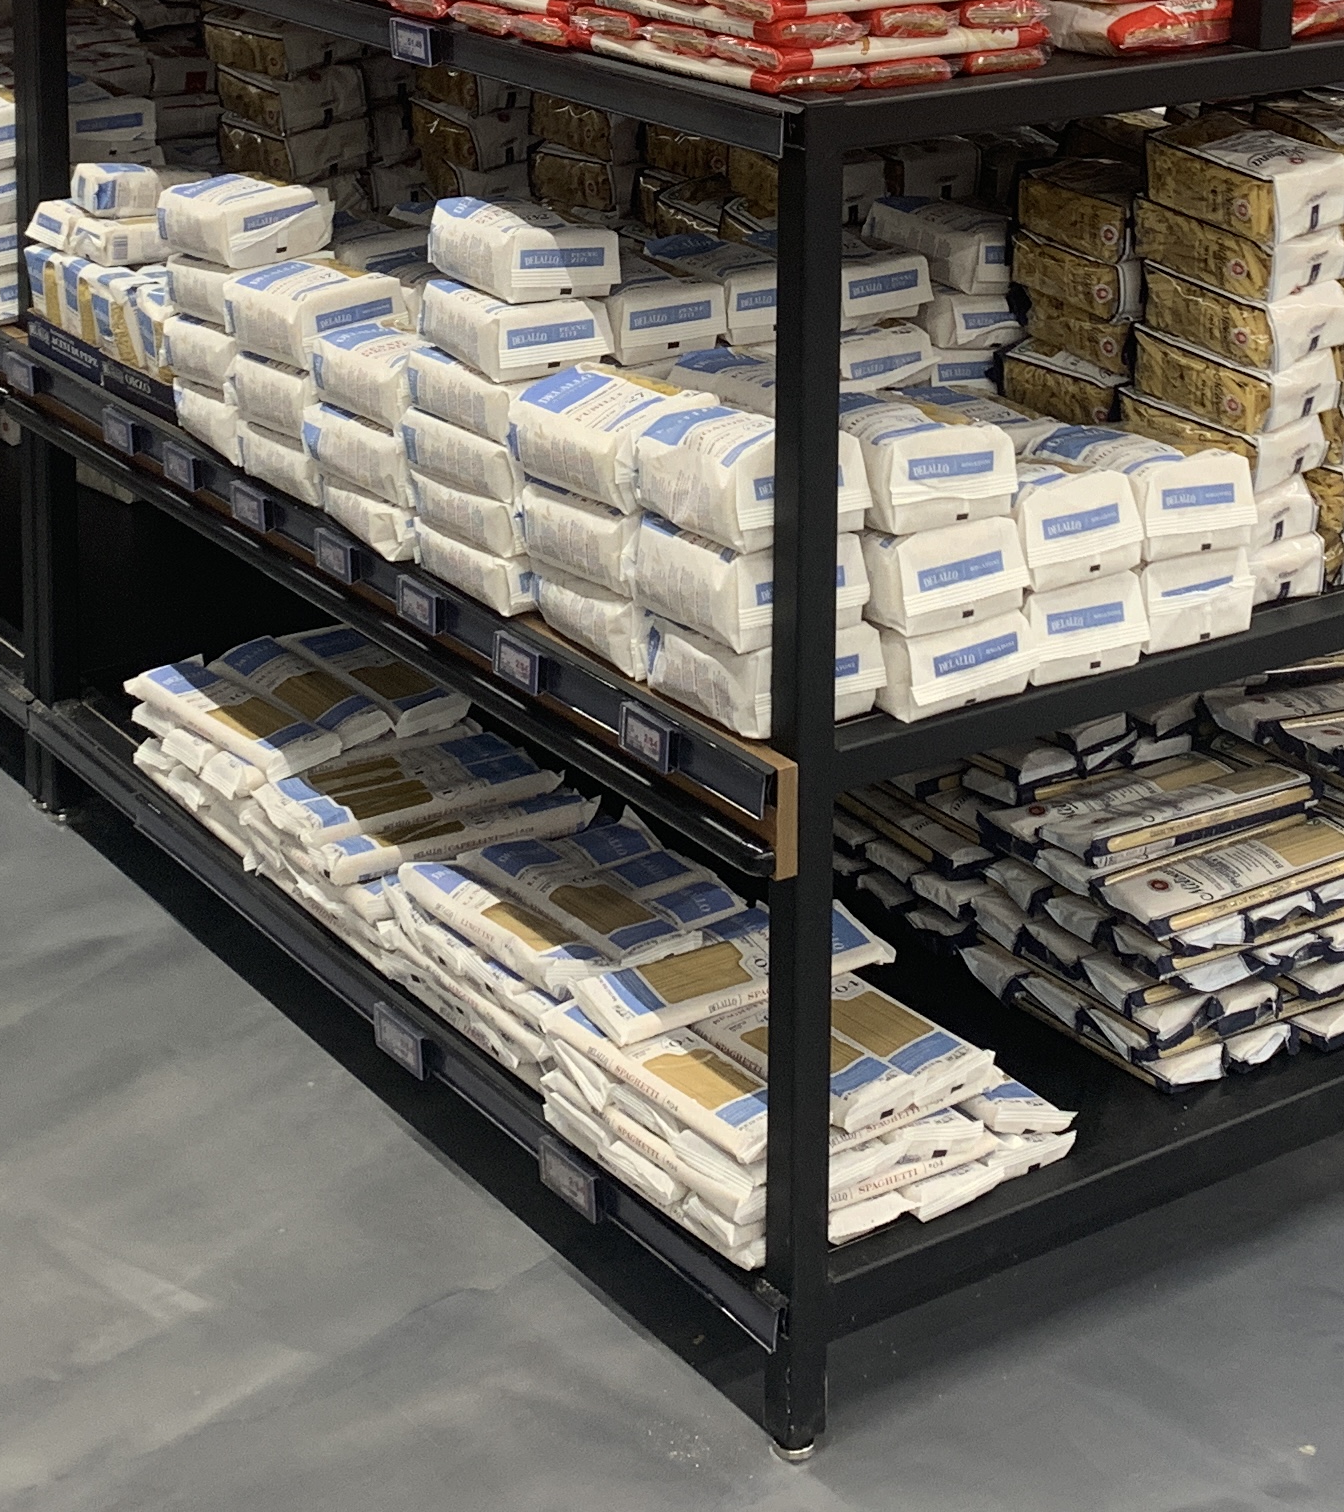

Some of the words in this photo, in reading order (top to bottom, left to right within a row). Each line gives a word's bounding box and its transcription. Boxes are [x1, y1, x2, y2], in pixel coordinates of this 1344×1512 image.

[525, 255, 559, 266] DELALLO
[316, 310, 353, 329] DELALLO
[633, 312, 669, 328] DELALLO
[512, 333, 548, 346] DELALLO
[912, 464, 949, 477] DELALLO
[1047, 521, 1082, 537] DELALLO
[922, 570, 959, 588] DELALLO
[1050, 614, 1084, 632] DELALLO
[937, 654, 976, 674] DELALLO
[615, 1064, 661, 1102] SPAGHETTI
[858, 1166, 920, 1196] SPAGHETTI
